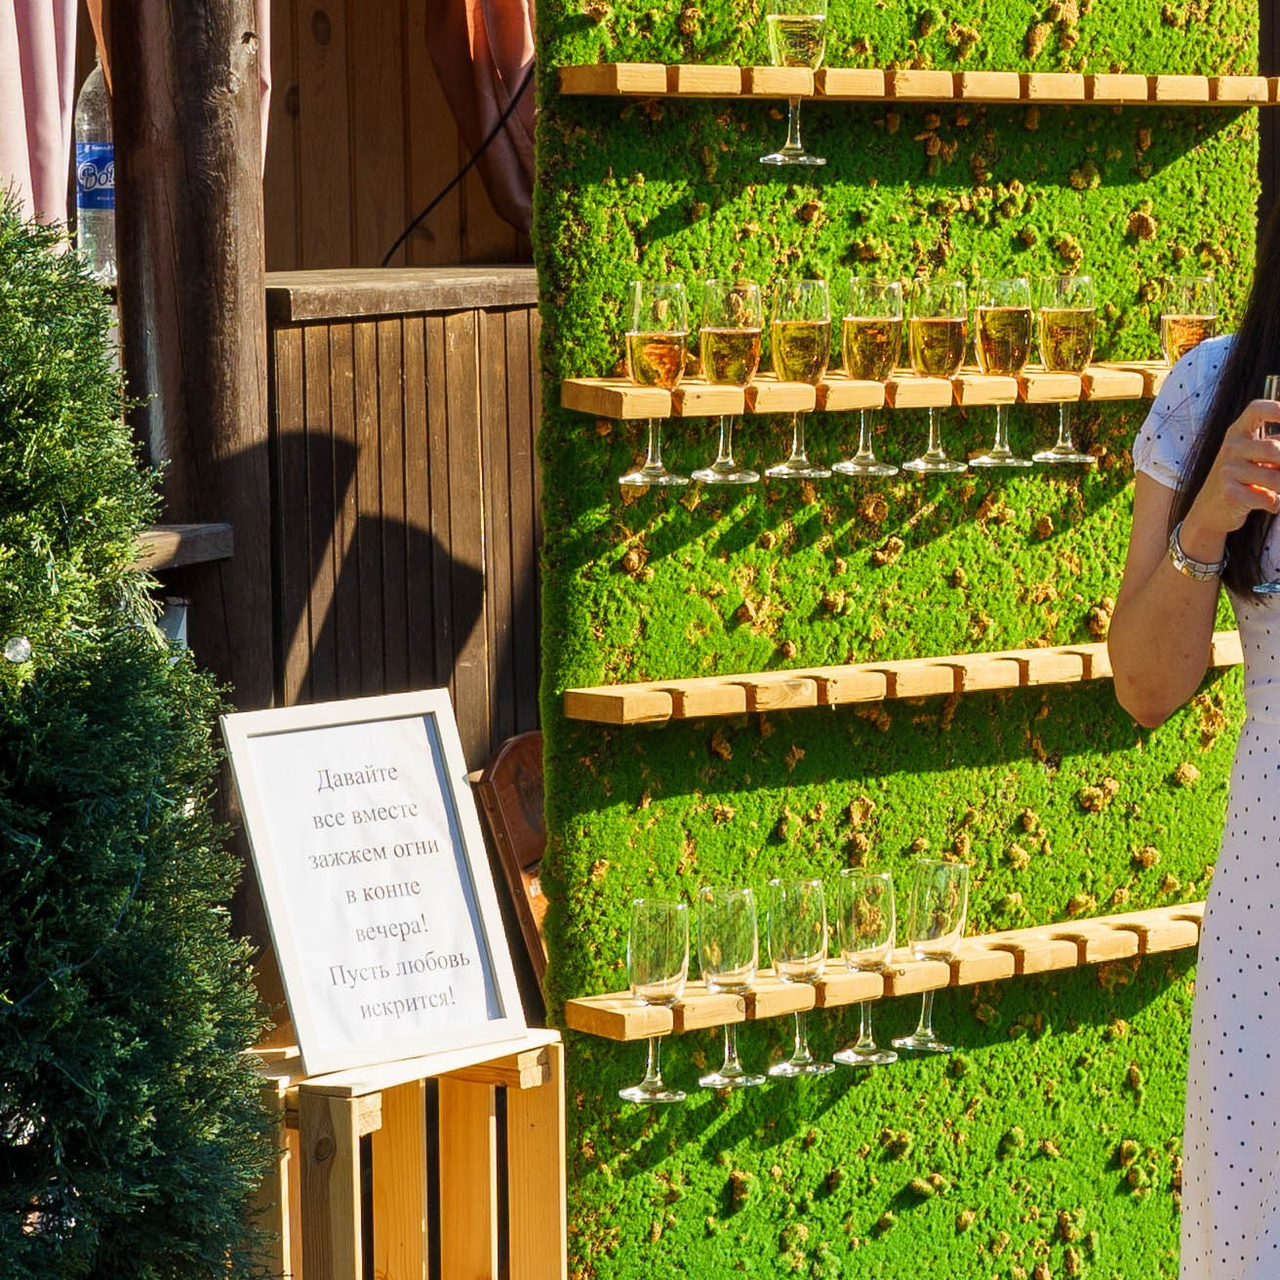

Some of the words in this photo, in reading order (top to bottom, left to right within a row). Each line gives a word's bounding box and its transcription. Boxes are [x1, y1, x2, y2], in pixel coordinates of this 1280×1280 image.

[316, 763, 399, 794] Давайте
[312, 811, 346, 830] все
[351, 802, 419, 825] вместе
[307, 845, 388, 871] зажжем
[393, 838, 440, 860] огни
[345, 889, 358, 905] в
[362, 879, 422, 903] конце
[355, 912, 429, 943] вечера!
[329, 964, 391, 990] Пусть
[395, 949, 471, 978] любовь
[359, 984, 457, 1021] искрится!
